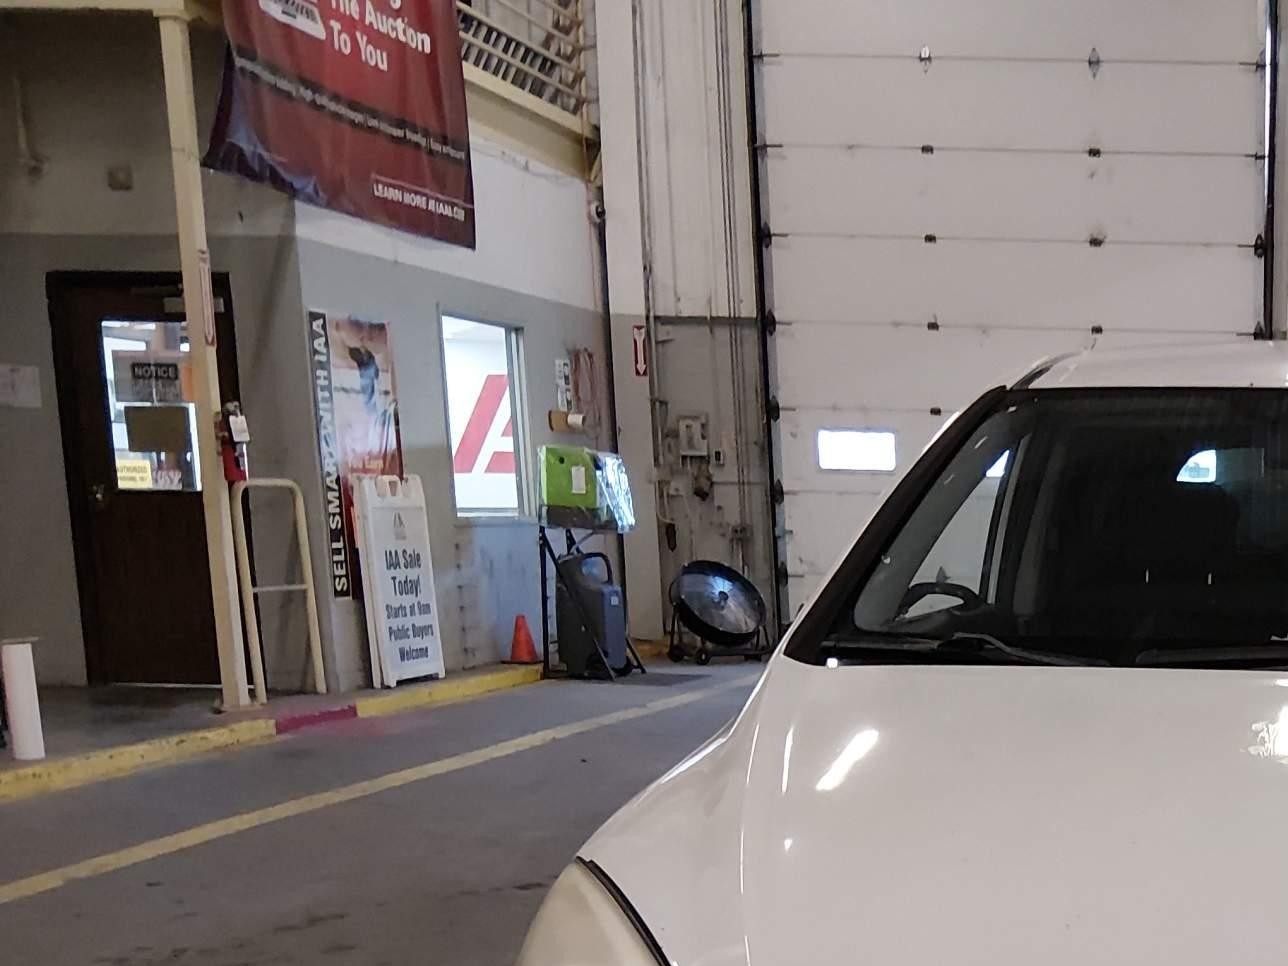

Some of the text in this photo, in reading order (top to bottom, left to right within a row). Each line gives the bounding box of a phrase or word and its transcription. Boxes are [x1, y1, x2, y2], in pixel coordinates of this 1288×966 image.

[365, 0, 432, 55] Auction
[329, 19, 389, 72] To You
[312, 318, 328, 362] IAA
[331, 537, 348, 592] SELL
[385, 548, 422, 571] IAA Sale
[391, 574, 422, 598] Today!
[385, 602, 408, 619] Starts
[388, 624, 411, 642] Public
